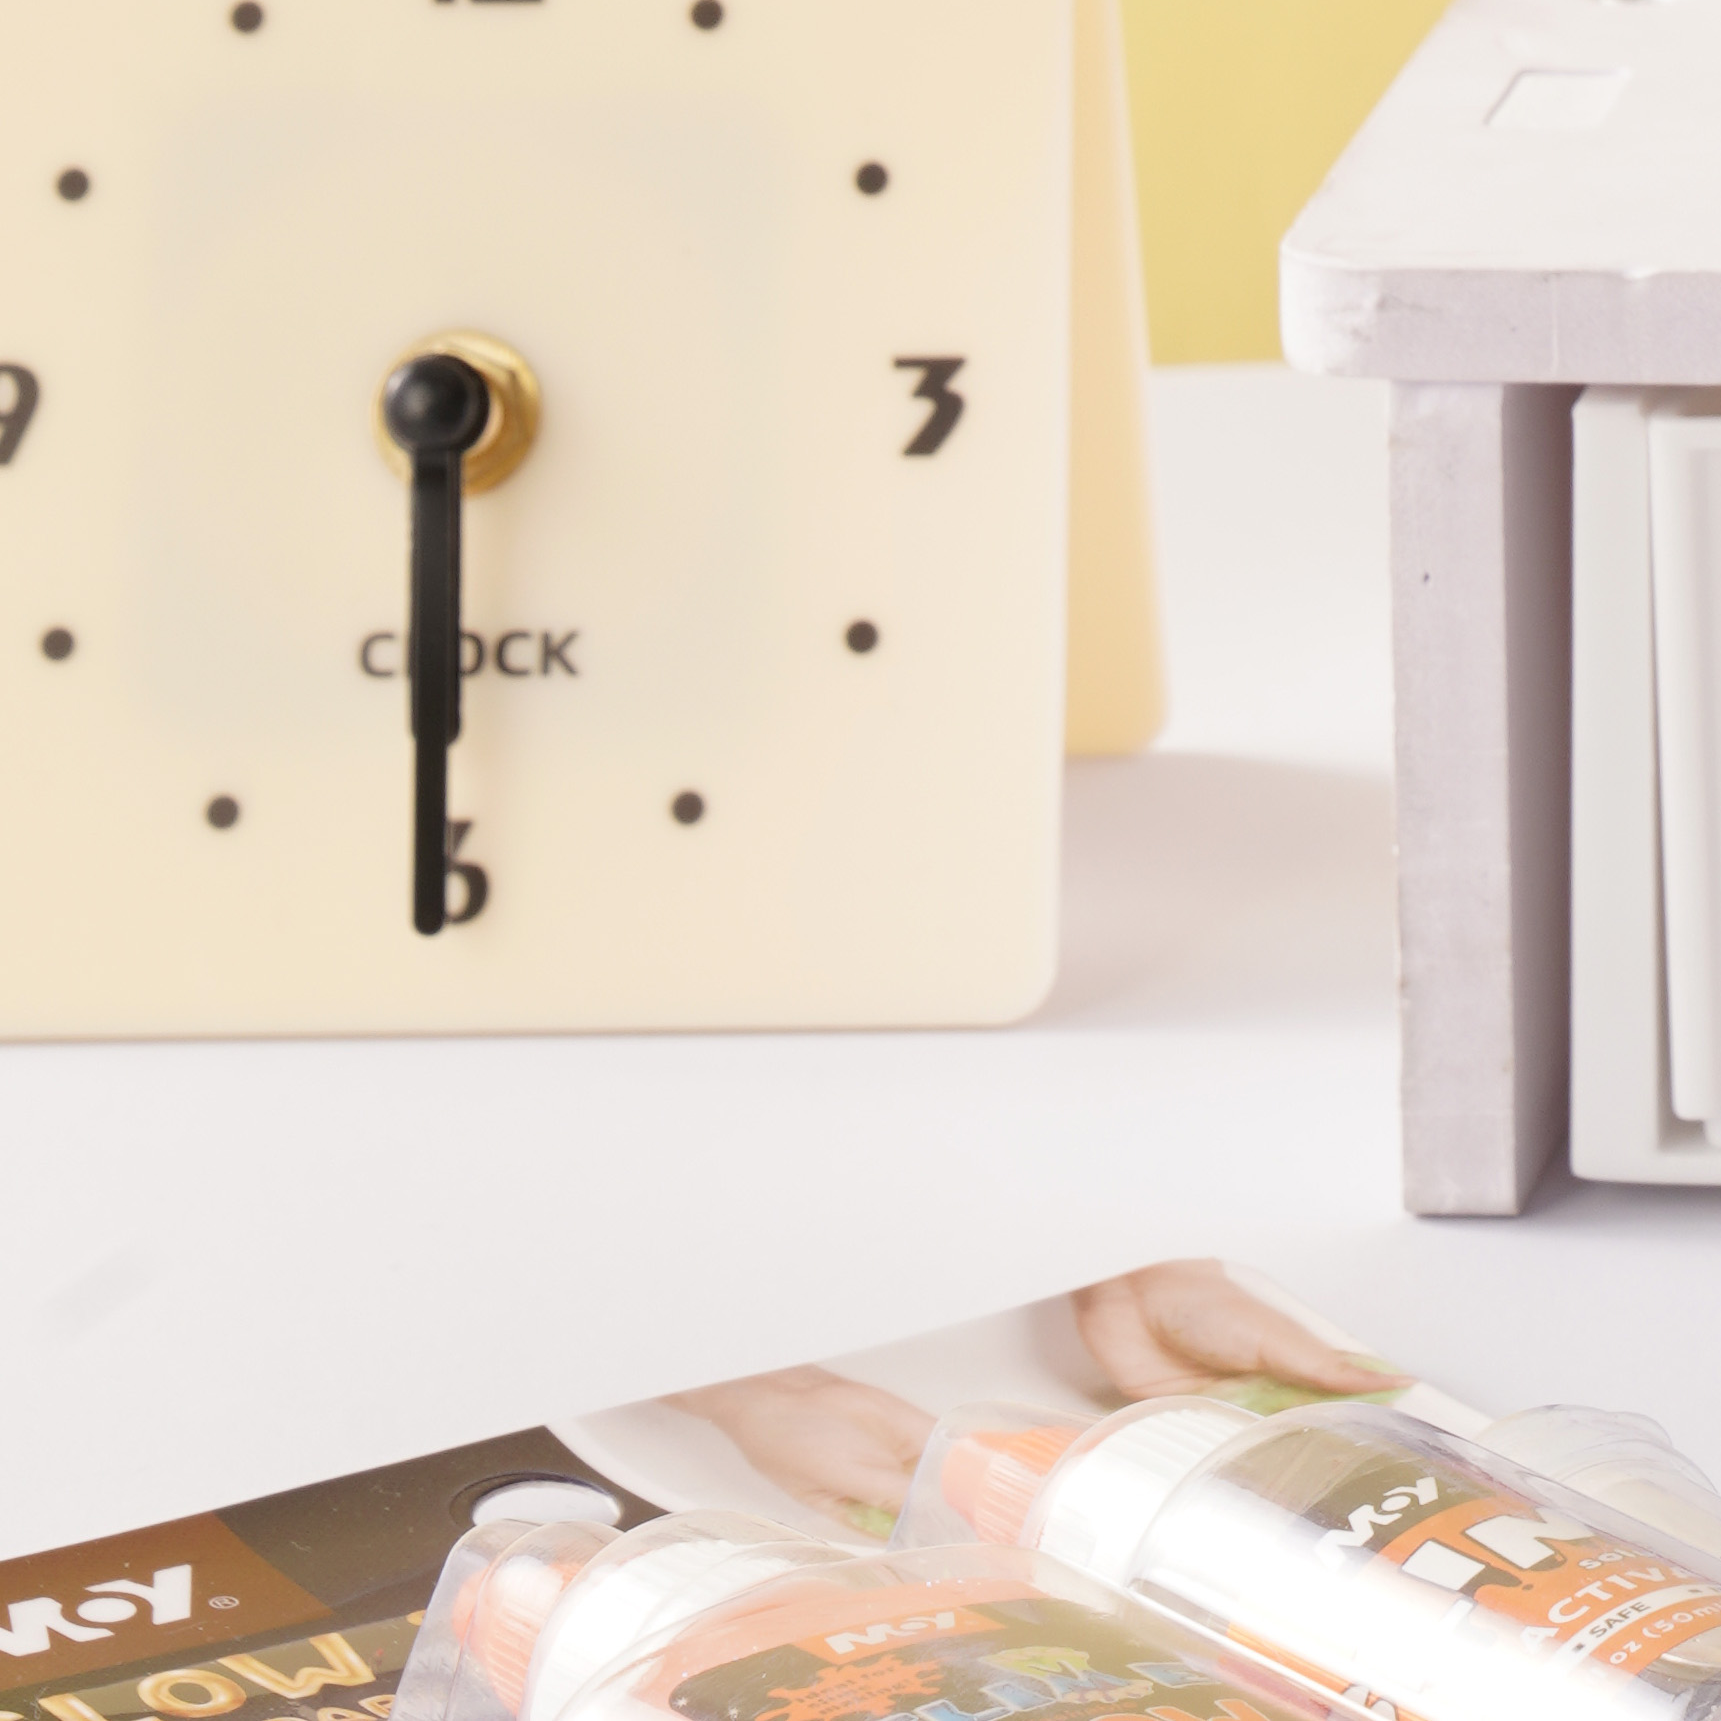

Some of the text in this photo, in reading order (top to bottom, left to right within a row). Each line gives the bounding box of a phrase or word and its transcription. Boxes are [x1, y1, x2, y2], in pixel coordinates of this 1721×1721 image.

[893, 357, 968, 456] 3
[359, 628, 580, 679] COCK
[1589, 1601, 1652, 1638] SAFE
[1610, 1640, 1642, 1665] oz
